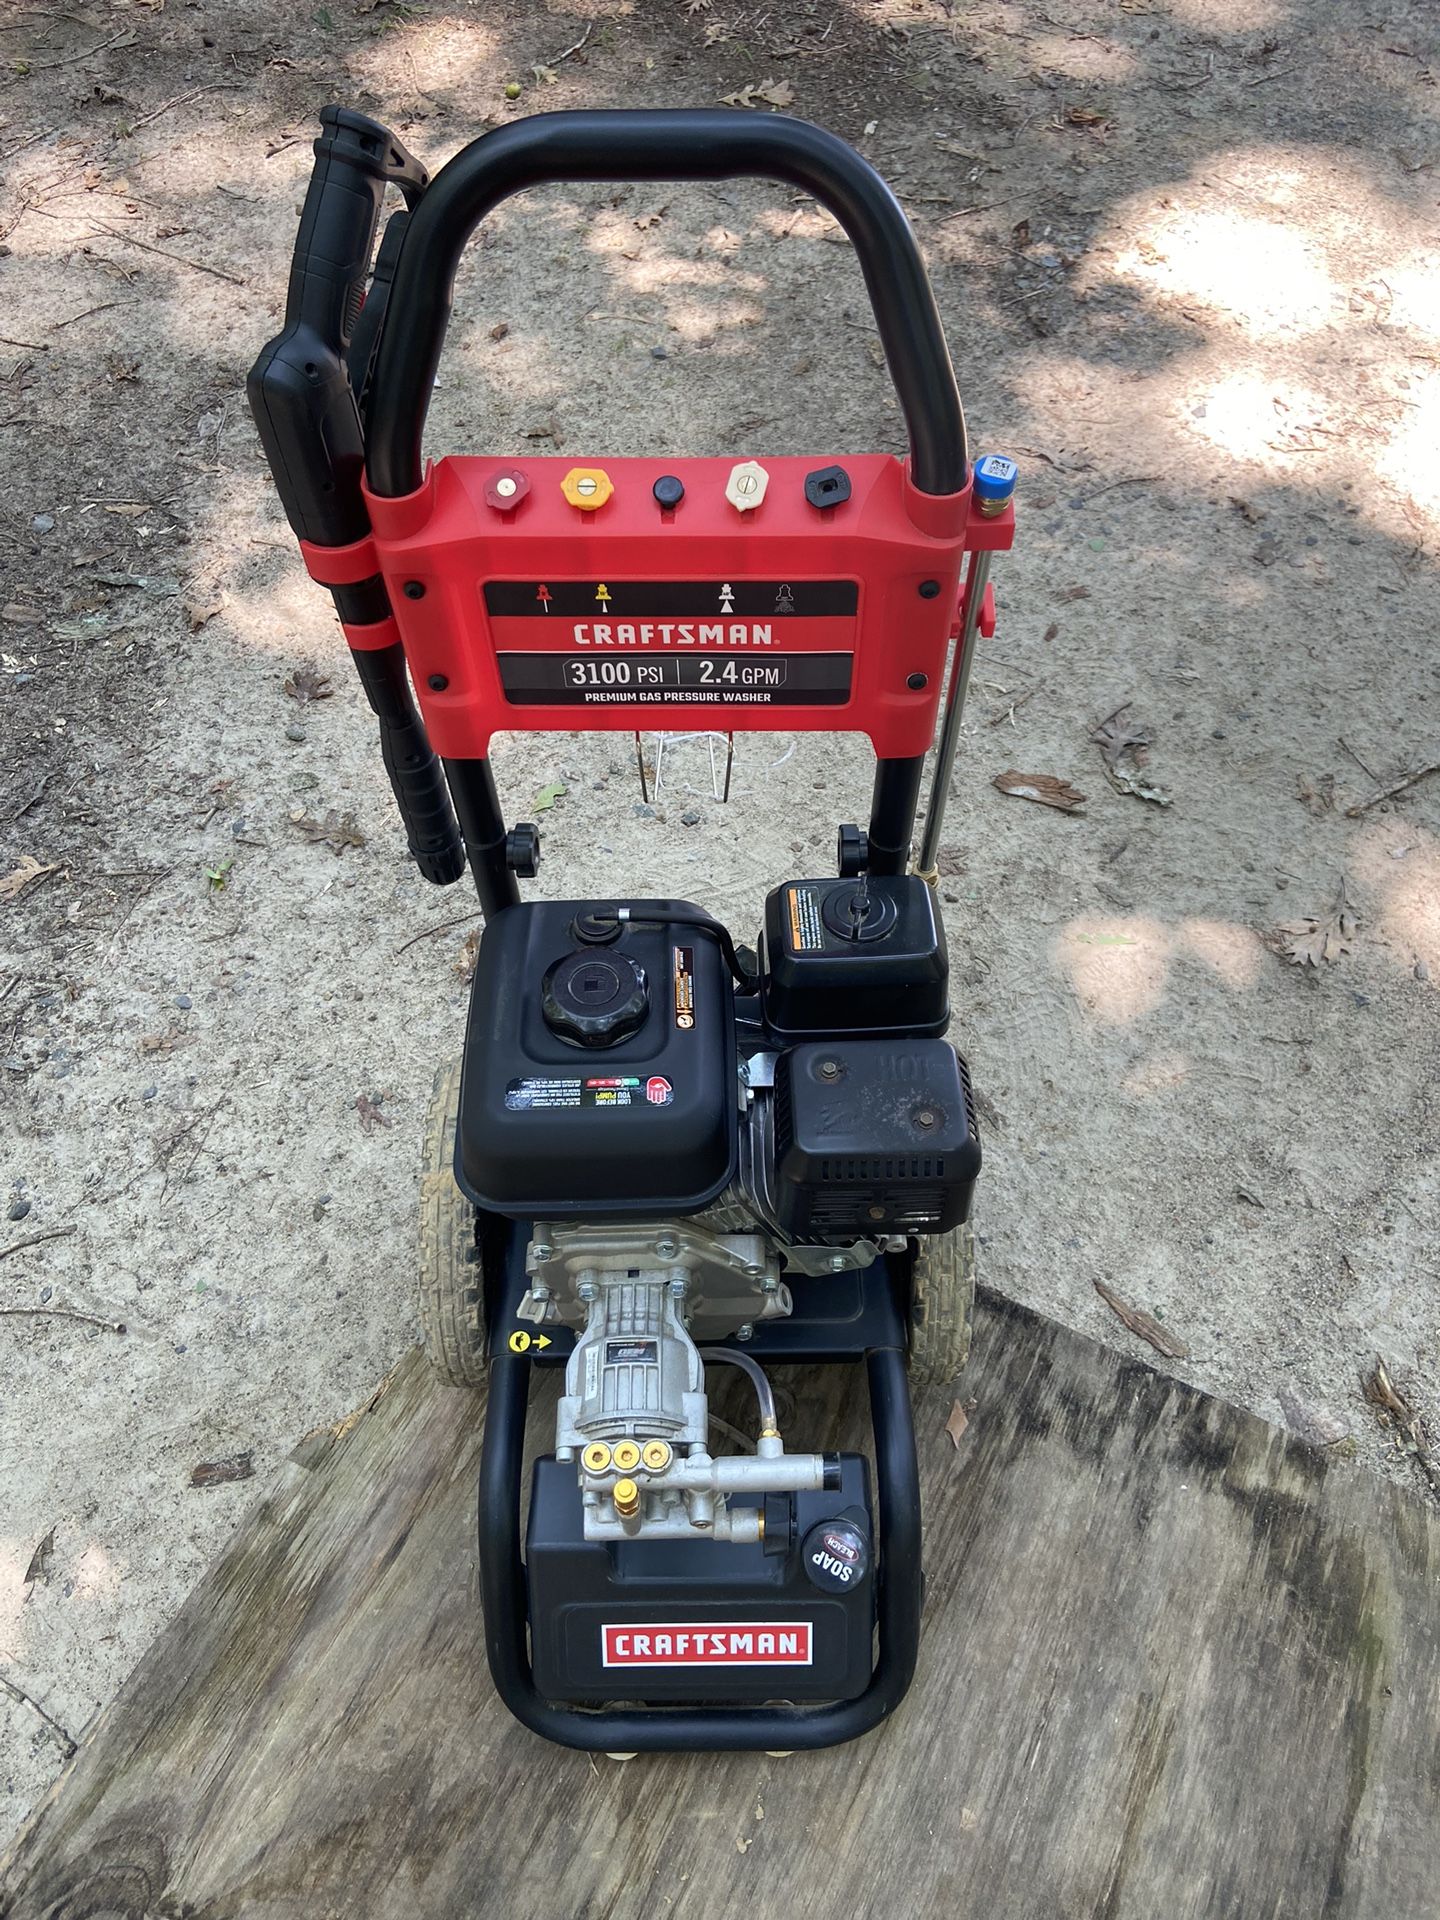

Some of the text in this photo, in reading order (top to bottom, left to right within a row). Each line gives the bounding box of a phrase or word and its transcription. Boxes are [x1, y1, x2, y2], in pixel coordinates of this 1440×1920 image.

[573, 624, 772, 645] CRAFTSMAN
[571, 660, 780, 685] 3100 PSI 2.4 GPM
[585, 692, 772, 702] PREMIUM GAS PRESSURE WASHER
[617, 1091, 631, 1099] YOU
[827, 1537, 855, 1559] BLEACH
[812, 1550, 853, 1582] SOAP
[615, 1633, 797, 1656] CRAFTSMAN
